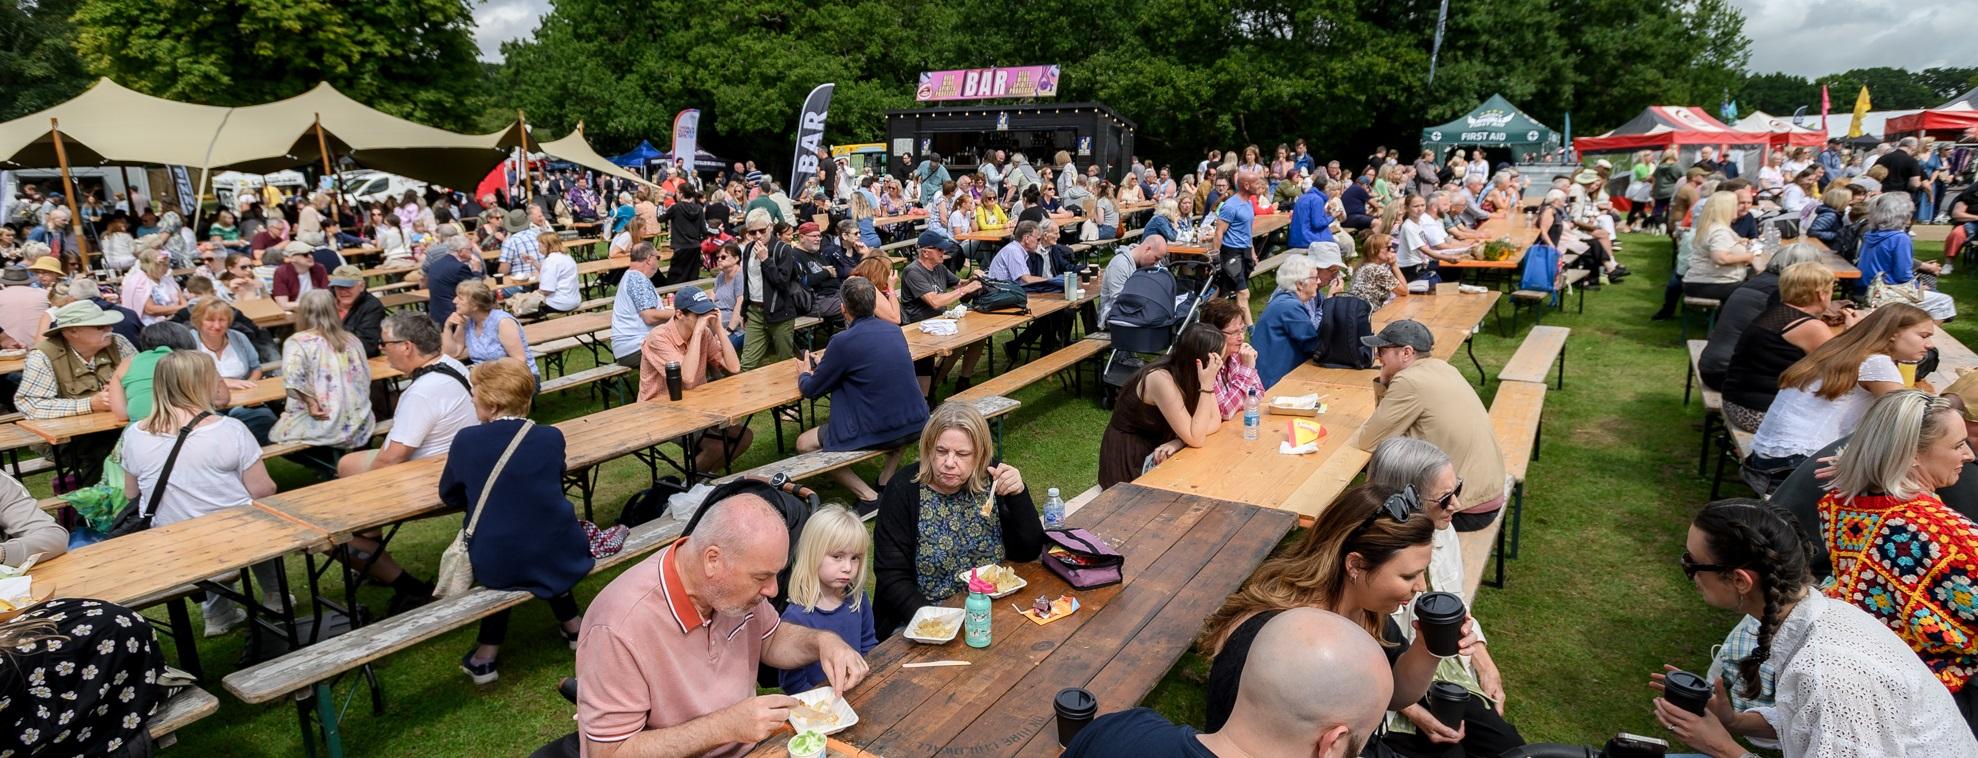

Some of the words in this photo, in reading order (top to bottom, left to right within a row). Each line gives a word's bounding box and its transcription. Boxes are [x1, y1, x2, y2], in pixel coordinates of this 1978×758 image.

[964, 70, 1008, 97] BAR
[798, 110, 828, 174] BAR
[1461, 131, 1488, 141] FIRST
[1489, 131, 1506, 141] AID
